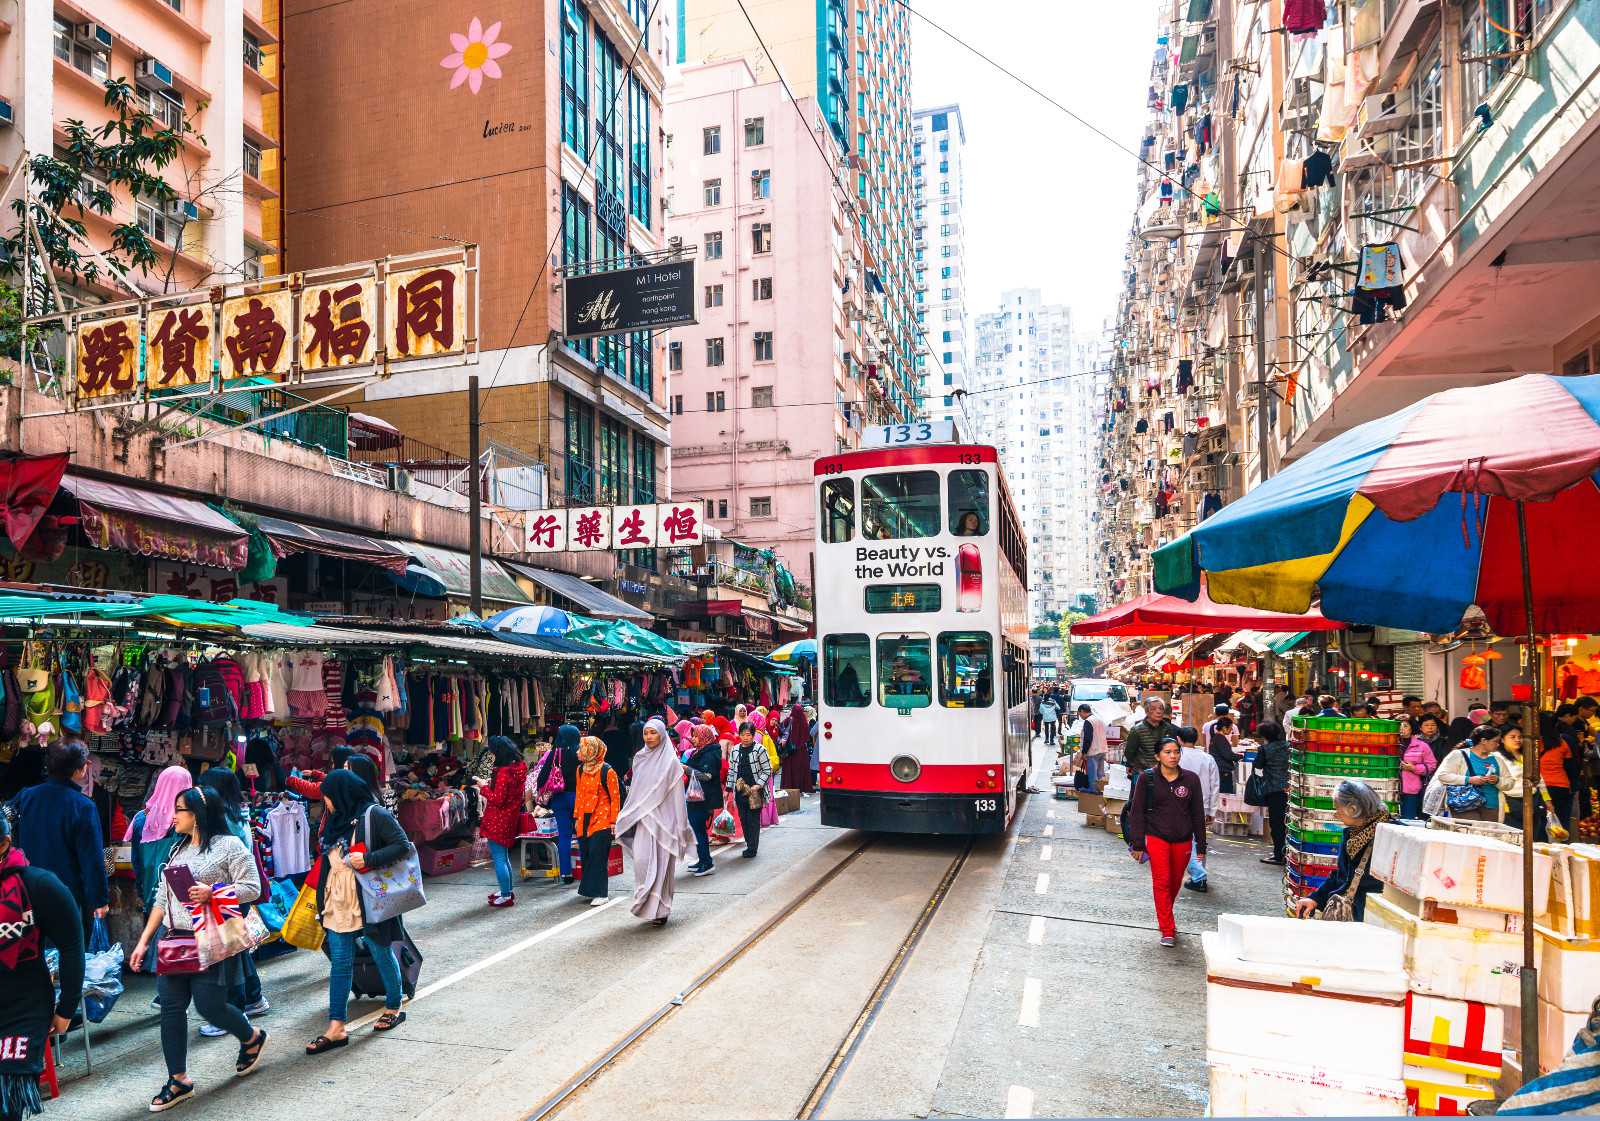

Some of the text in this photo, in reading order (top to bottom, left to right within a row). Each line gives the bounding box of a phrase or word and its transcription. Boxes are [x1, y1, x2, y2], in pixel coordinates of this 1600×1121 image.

[636, 270, 681, 286] M1 Hotel
[642, 293, 675, 304] northpoint
[884, 424, 932, 443] 133
[958, 453, 981, 465] 133
[823, 464, 843, 476] 133
[530, 506, 699, 548] 恒生藥行
[856, 545, 951, 562] Beauty vs.
[855, 562, 944, 579] the World
[891, 592, 915, 607] 北角
[975, 799, 996, 812] 133
[0, 1036, 29, 1060] LE
